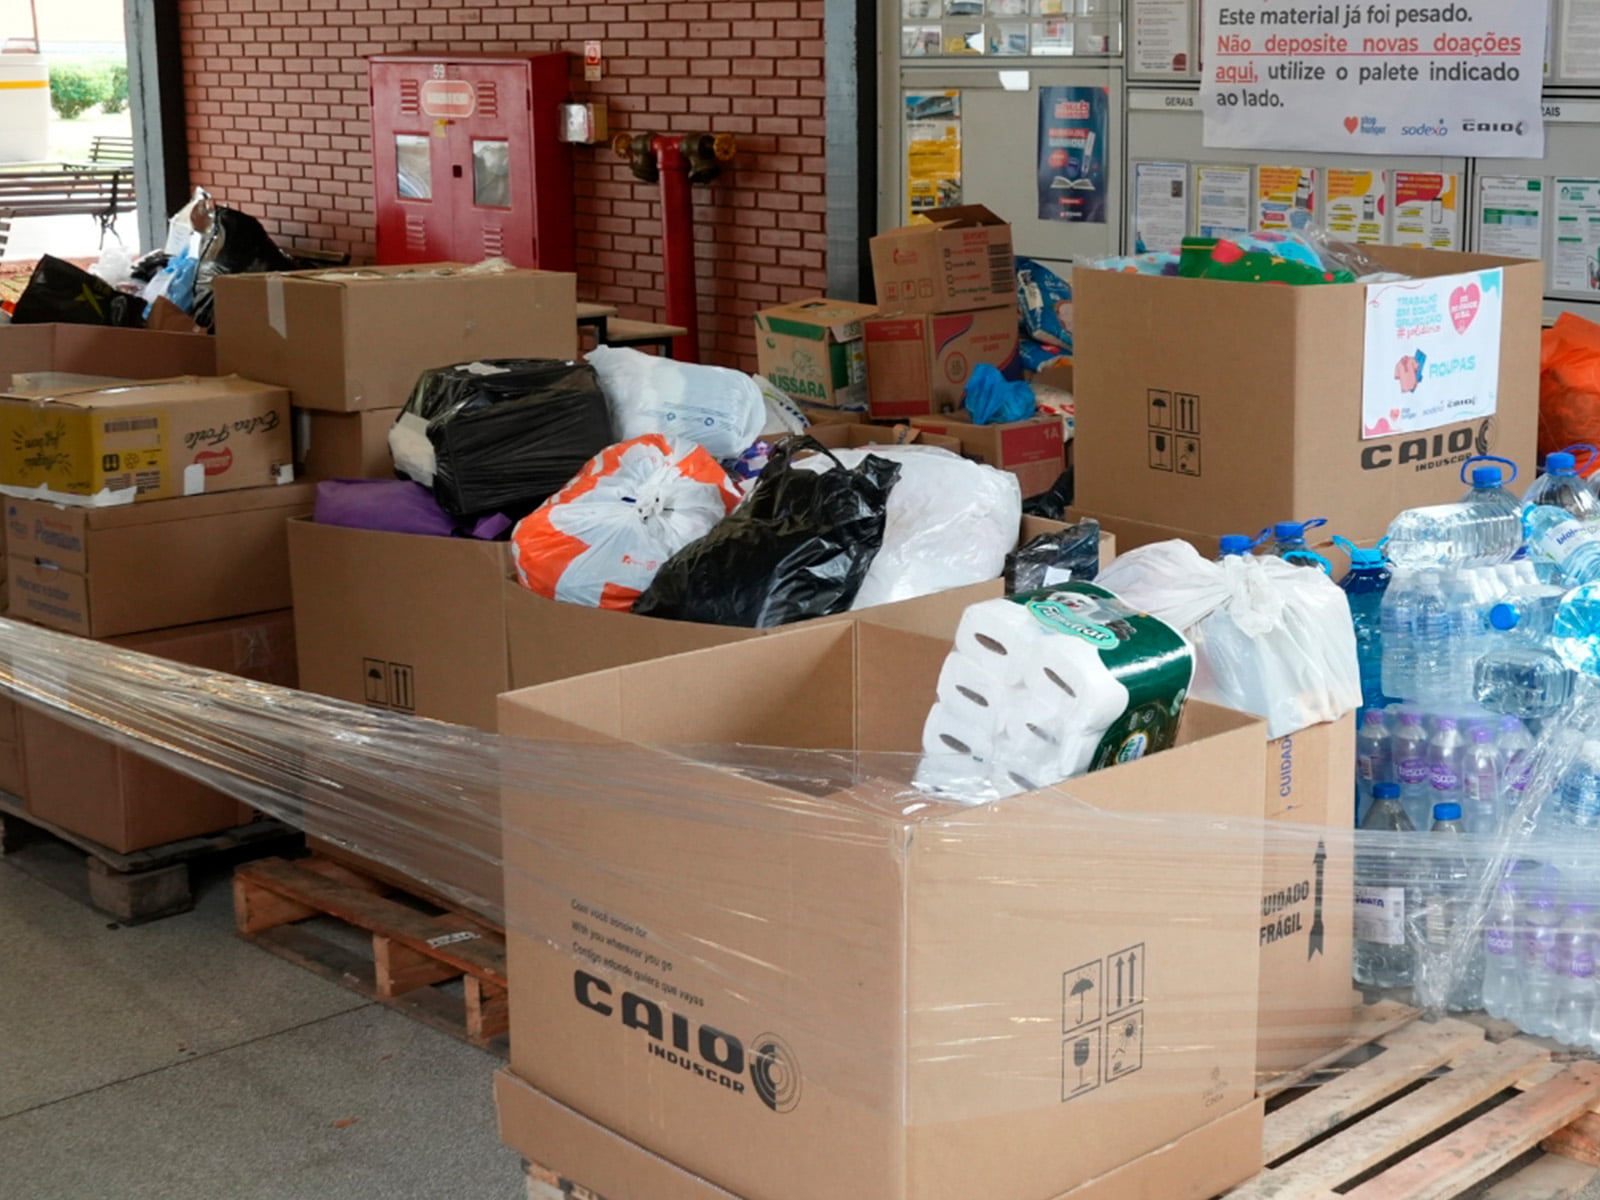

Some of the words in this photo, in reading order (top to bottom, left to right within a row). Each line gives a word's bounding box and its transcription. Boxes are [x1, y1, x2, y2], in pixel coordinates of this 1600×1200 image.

[1218, 8, 1255, 25] Este
[1260, 5, 1339, 25] material
[1342, 4, 1361, 28] já
[1367, 4, 1390, 24] foi
[1395, 3, 1473, 28] pesado.
[1217, 34, 1251, 52] Não
[1264, 33, 1348, 56] deposite
[1363, 37, 1419, 52] novas
[1433, 32, 1521, 57] doações
[1215, 61, 1258, 83] aqui,
[1268, 61, 1325, 81] utilize
[1336, 66, 1349, 81] o
[1359, 62, 1419, 85] palete
[1430, 61, 1520, 81] indicado
[1165, 96, 1194, 107] GERAIS
[1216, 92, 1239, 106] ao
[1242, 88, 1284, 107] lado.
[1463, 122, 1513, 132] CAIO
[1429, 355, 1476, 377] ROUPAS
[1361, 427, 1473, 470] CAIO
[1261, 880, 1310, 916] UIDADO
[1259, 911, 1303, 946] FRÁGIL
[590, 931, 605, 943] you
[644, 953, 660, 967] you
[661, 960, 673, 972] go
[661, 982, 677, 996] que
[574, 969, 745, 1075] CAIO
[648, 1042, 745, 1095] INDUSCAR
